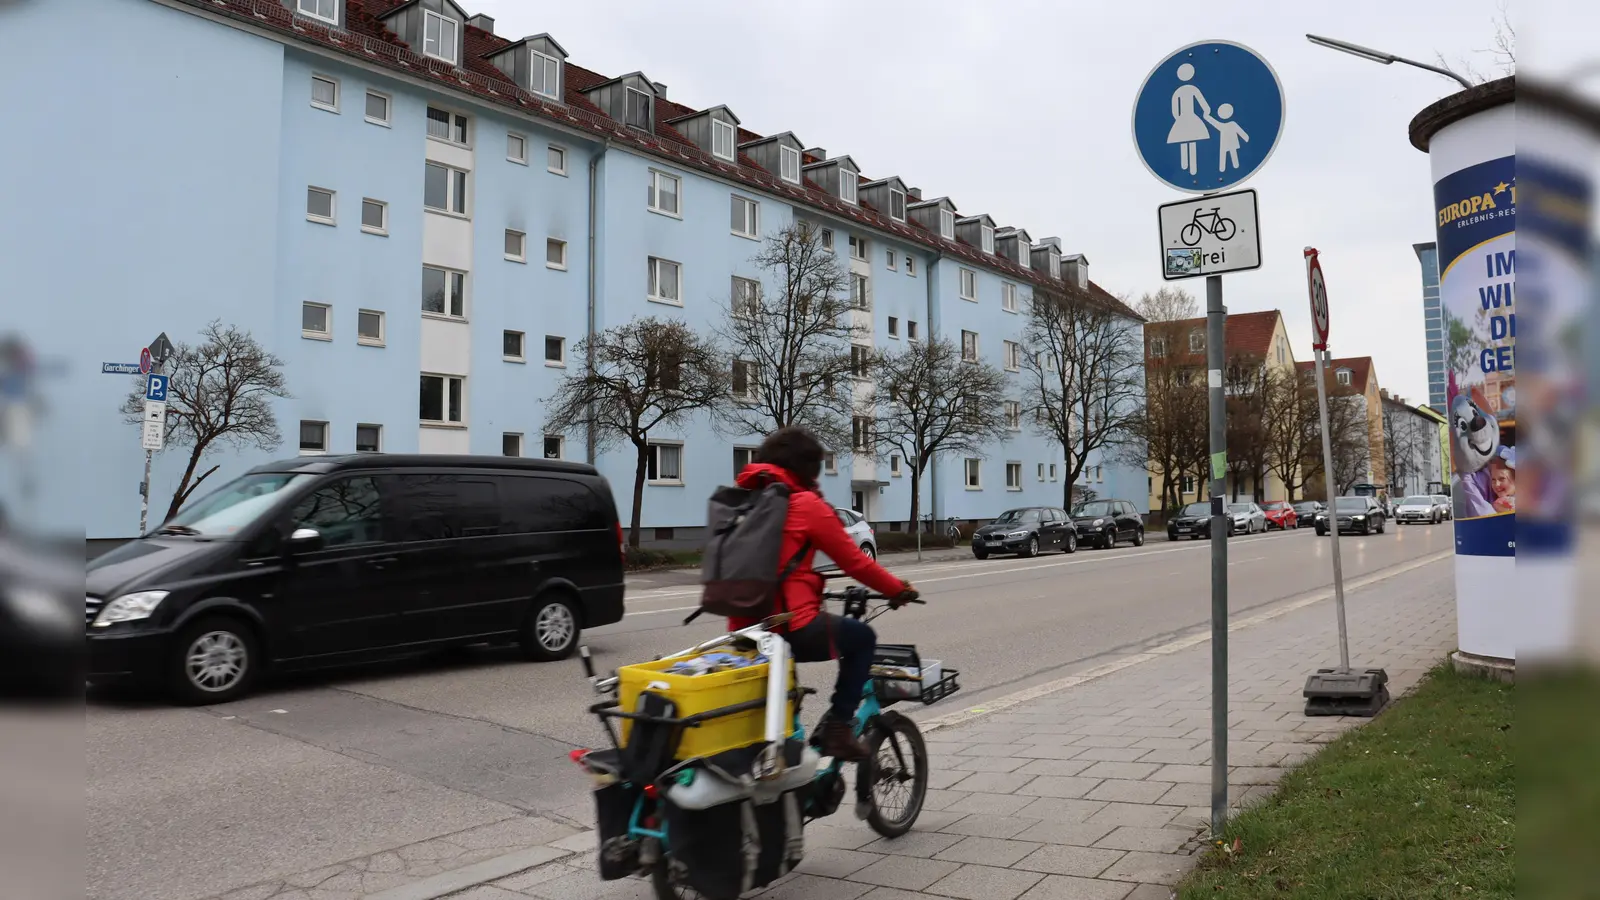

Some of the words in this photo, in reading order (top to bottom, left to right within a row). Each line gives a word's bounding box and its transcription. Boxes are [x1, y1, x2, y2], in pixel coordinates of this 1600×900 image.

[1438, 193, 1496, 226] EUROPA
[1202, 247, 1225, 265] rei
[1478, 282, 1515, 311] WI
[104, 363, 139, 374] Garchinger
[1480, 345, 1515, 374] GE
[150, 378, 162, 396] P
